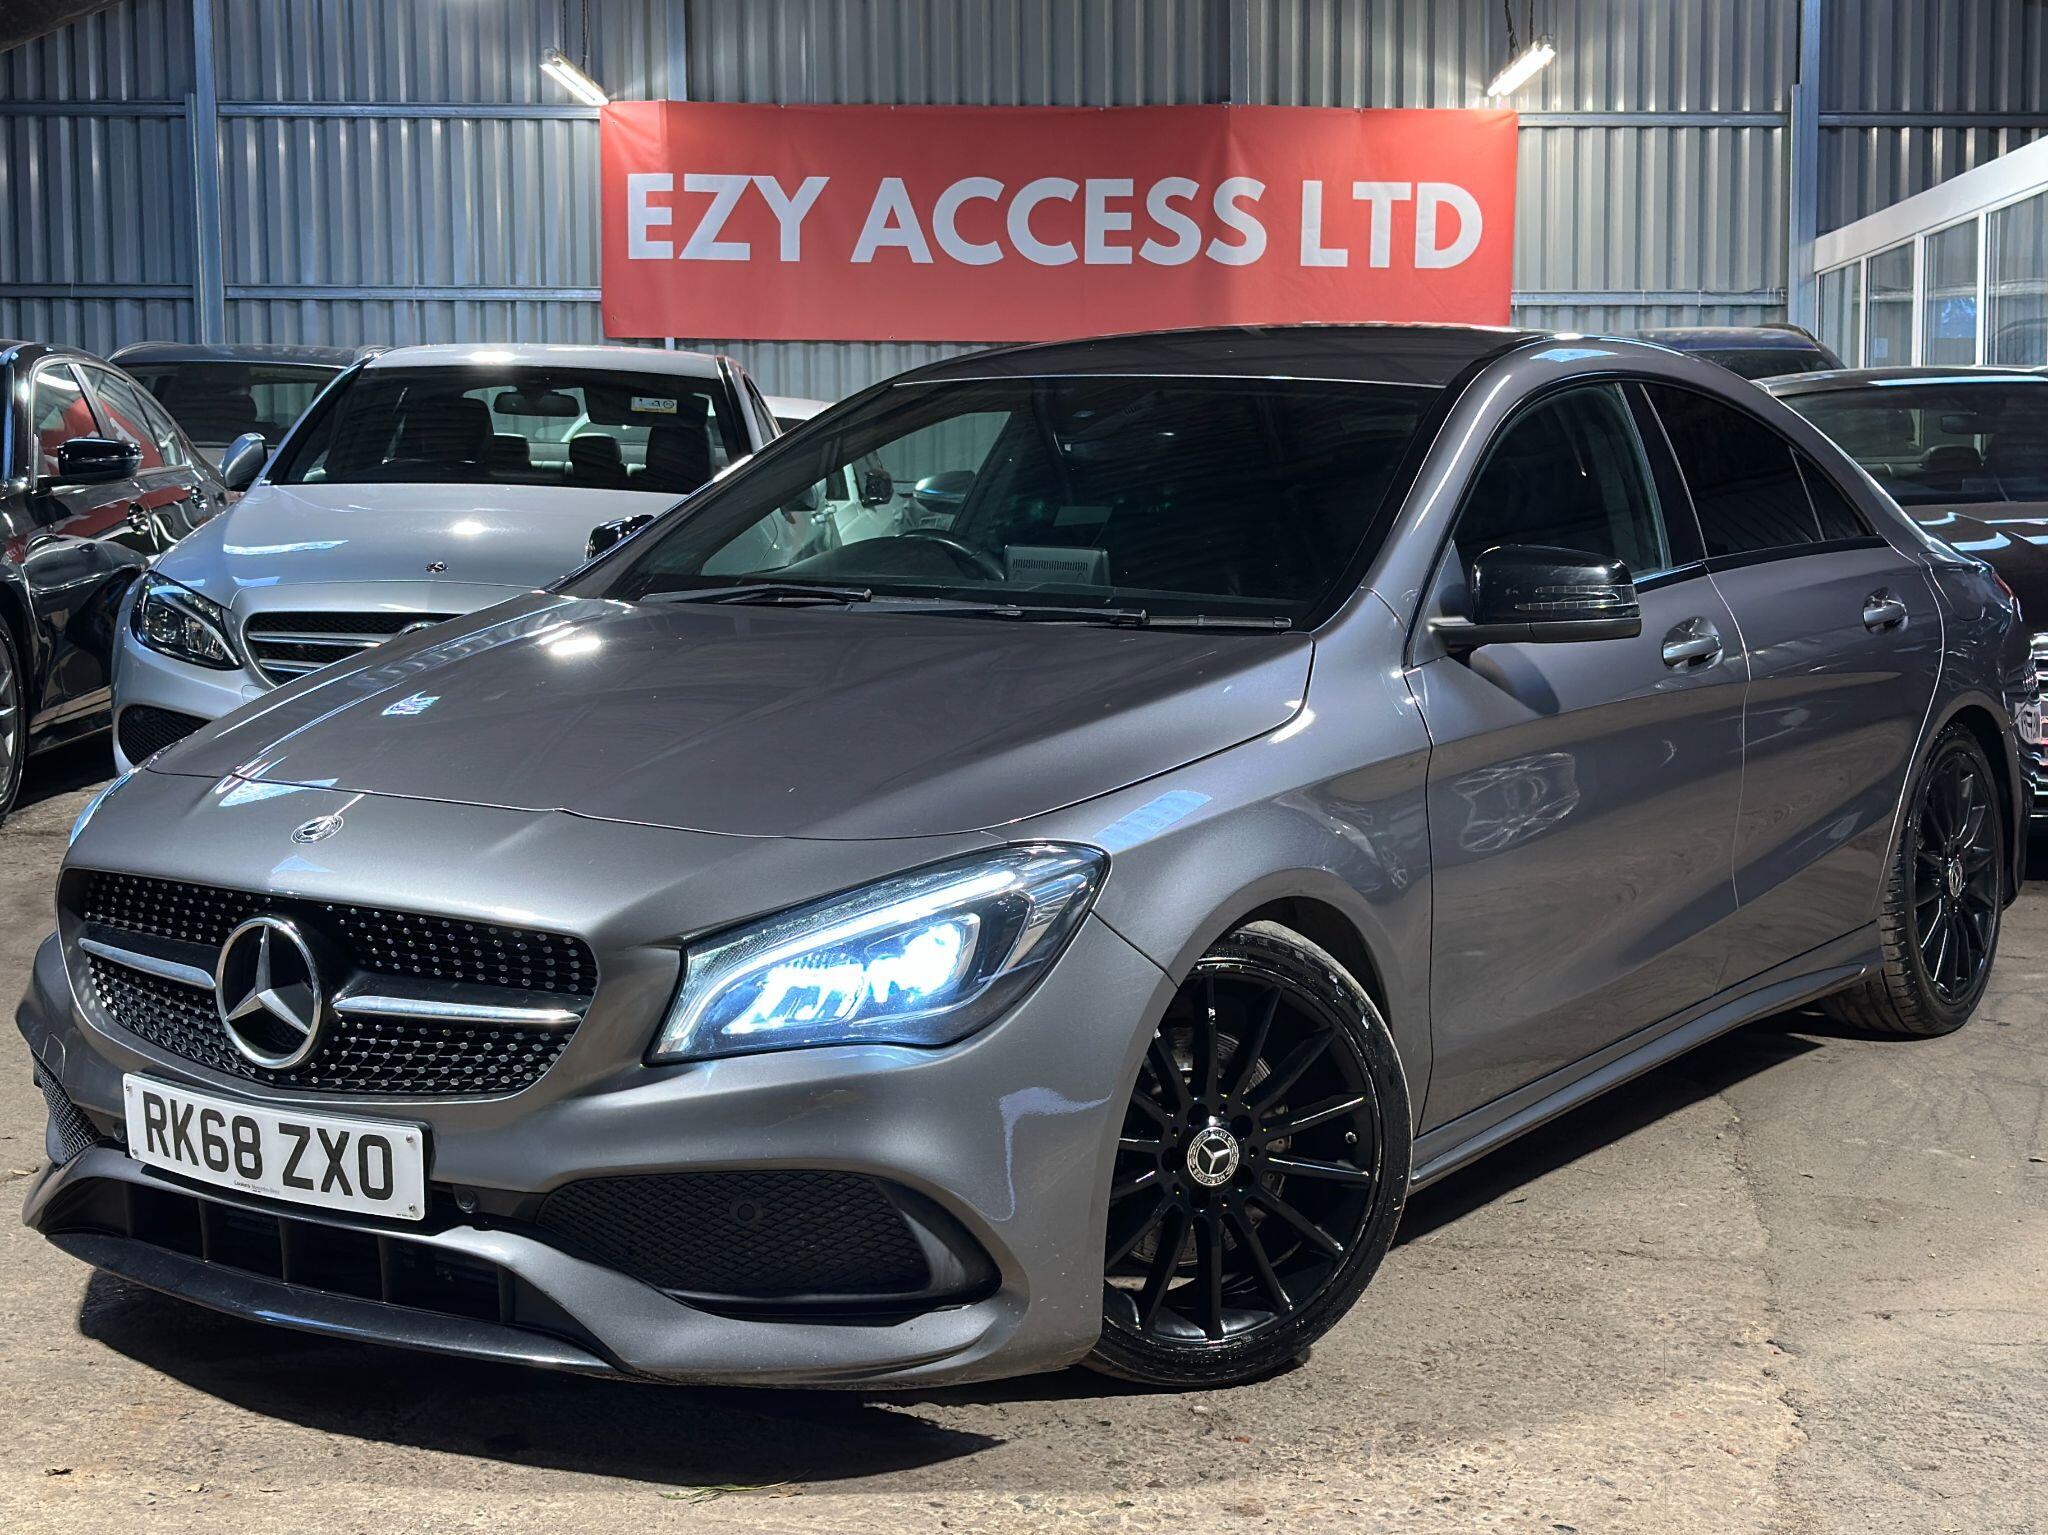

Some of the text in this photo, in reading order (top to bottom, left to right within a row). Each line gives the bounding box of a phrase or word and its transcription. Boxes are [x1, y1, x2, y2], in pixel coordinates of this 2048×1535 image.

[627, 172, 1483, 269] EZY ACCESS LTD
[143, 1091, 394, 1201] RK68 ZXO
